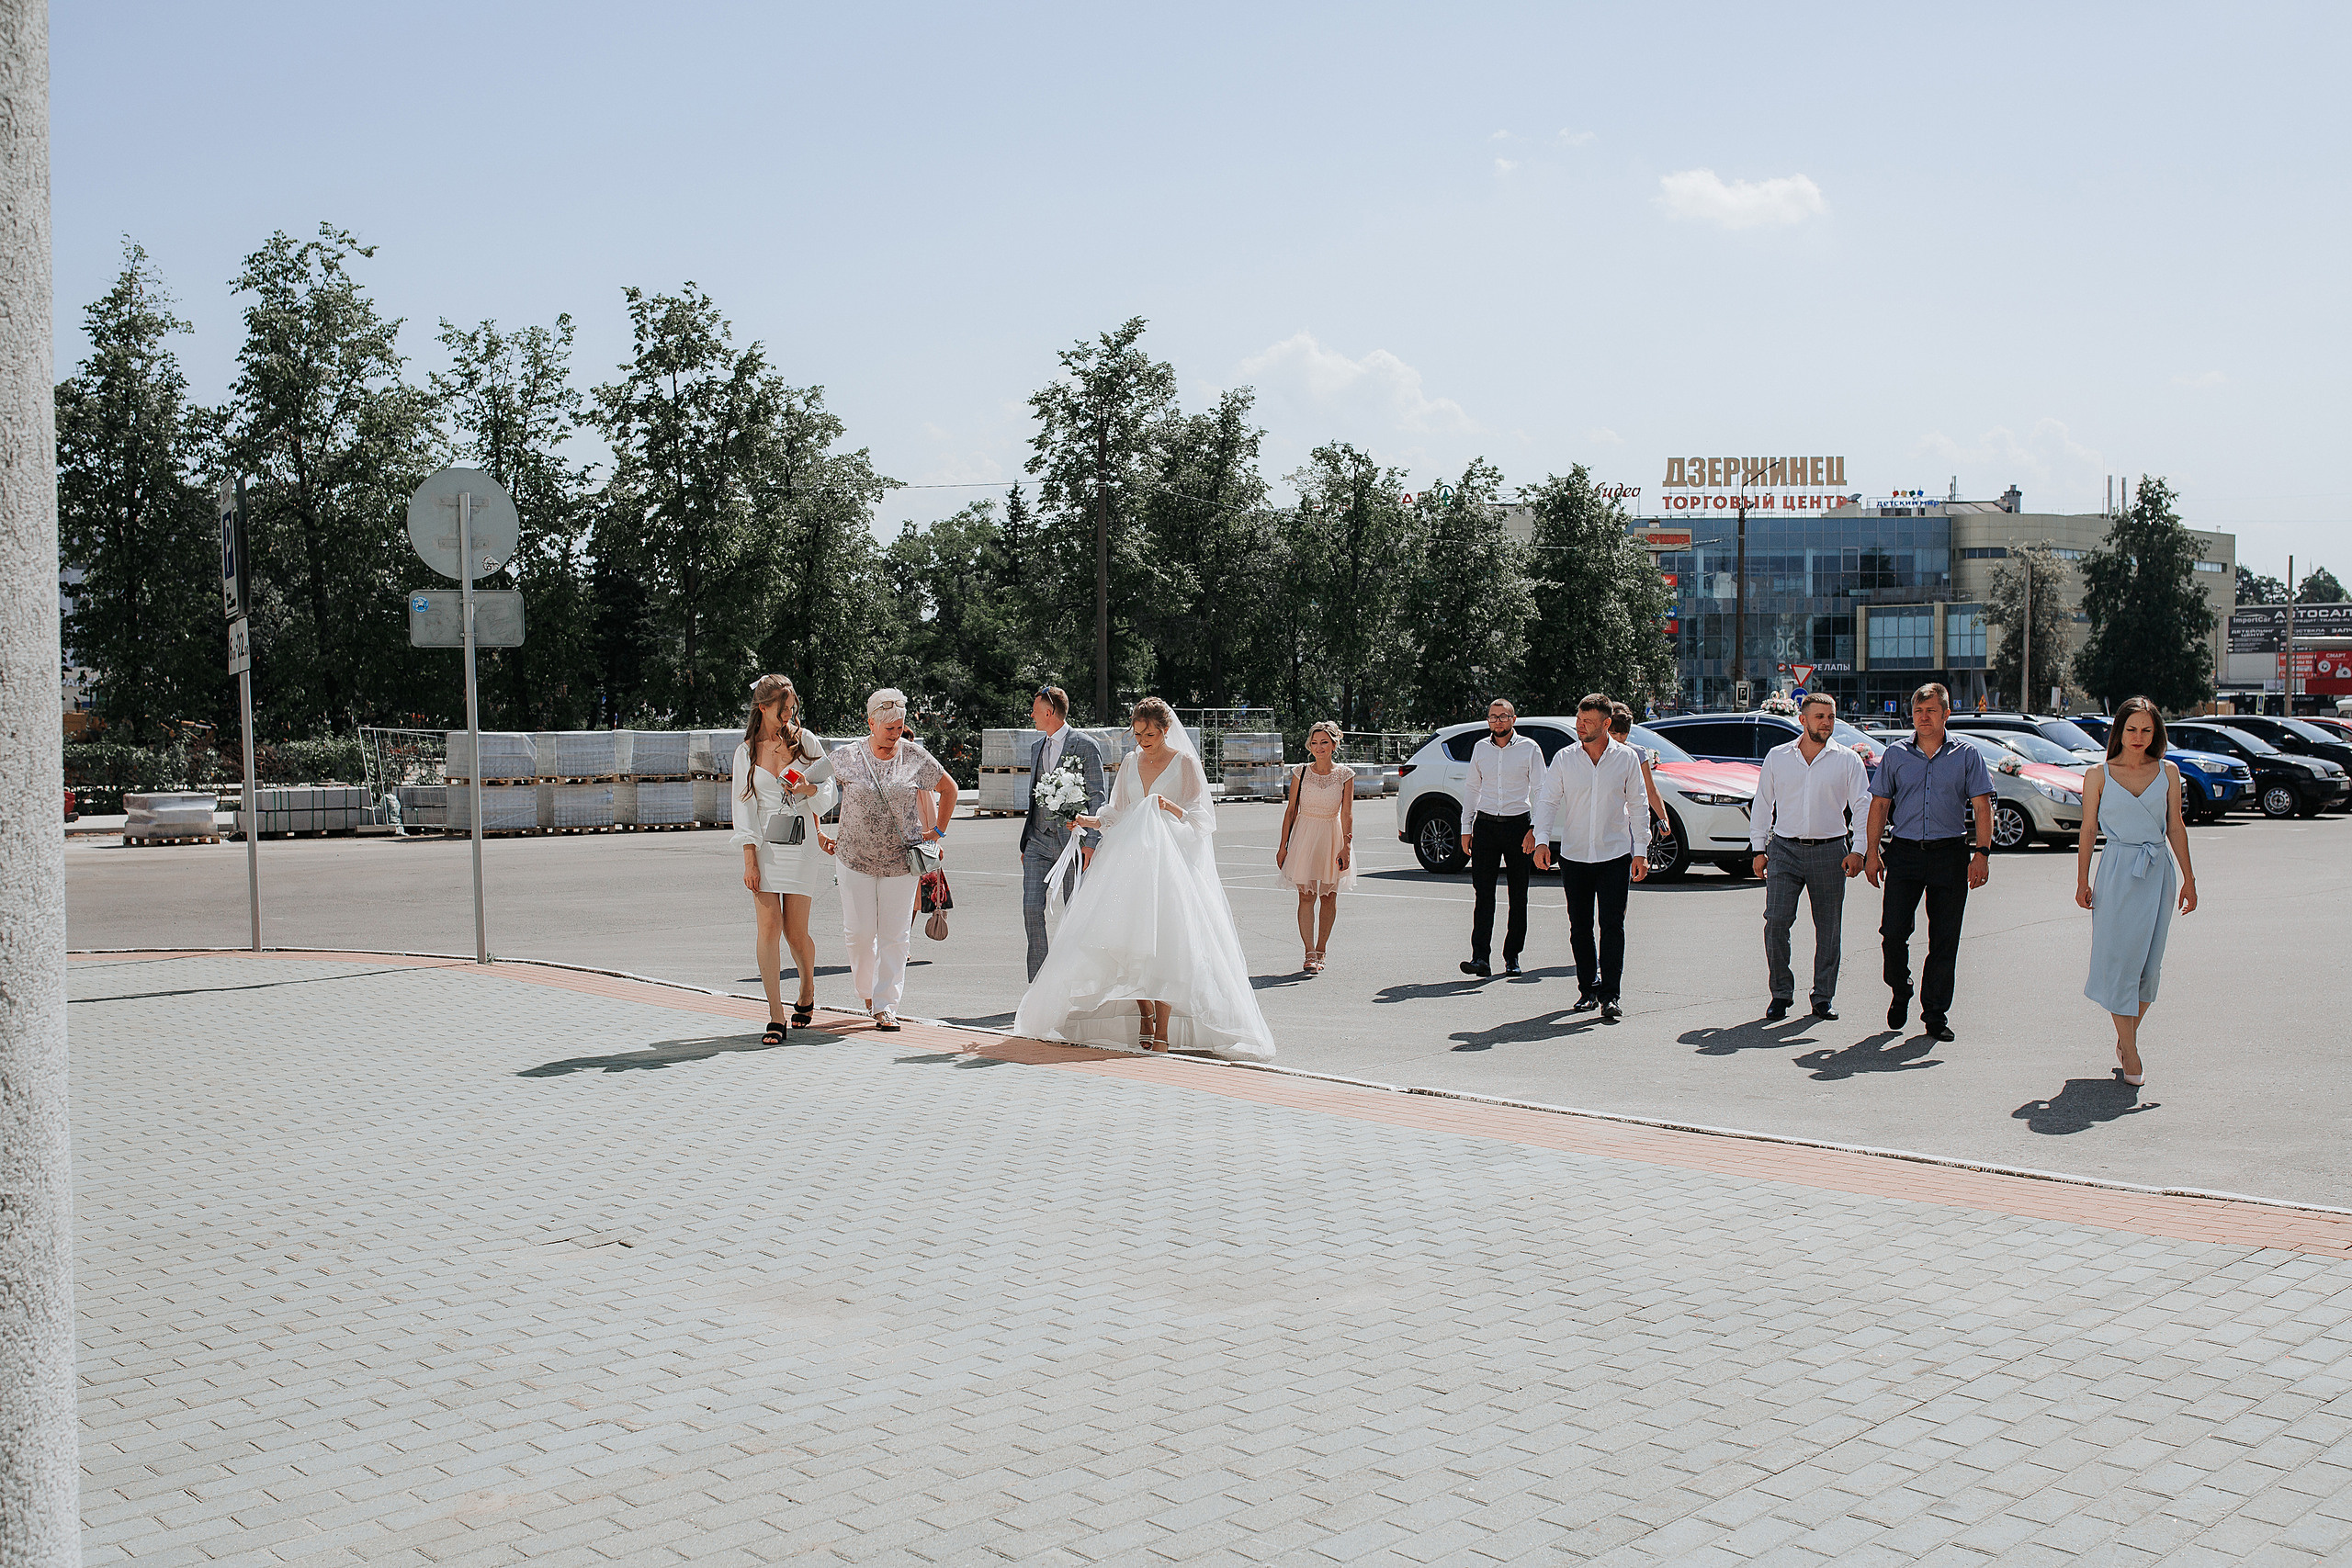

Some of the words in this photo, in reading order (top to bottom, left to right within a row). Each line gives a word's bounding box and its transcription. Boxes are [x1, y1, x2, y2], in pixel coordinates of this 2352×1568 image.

[1662, 456, 1847, 488] ДЗЕРЖИНЕЦ
[1662, 492, 1774, 510] ТОРГОВЫЙ
[1782, 495, 1848, 512] ЦЕНТР
[1877, 497, 1918, 508] детский
[1920, 500, 1939, 508] мир
[1824, 663, 1851, 671] ЛАПЫ
